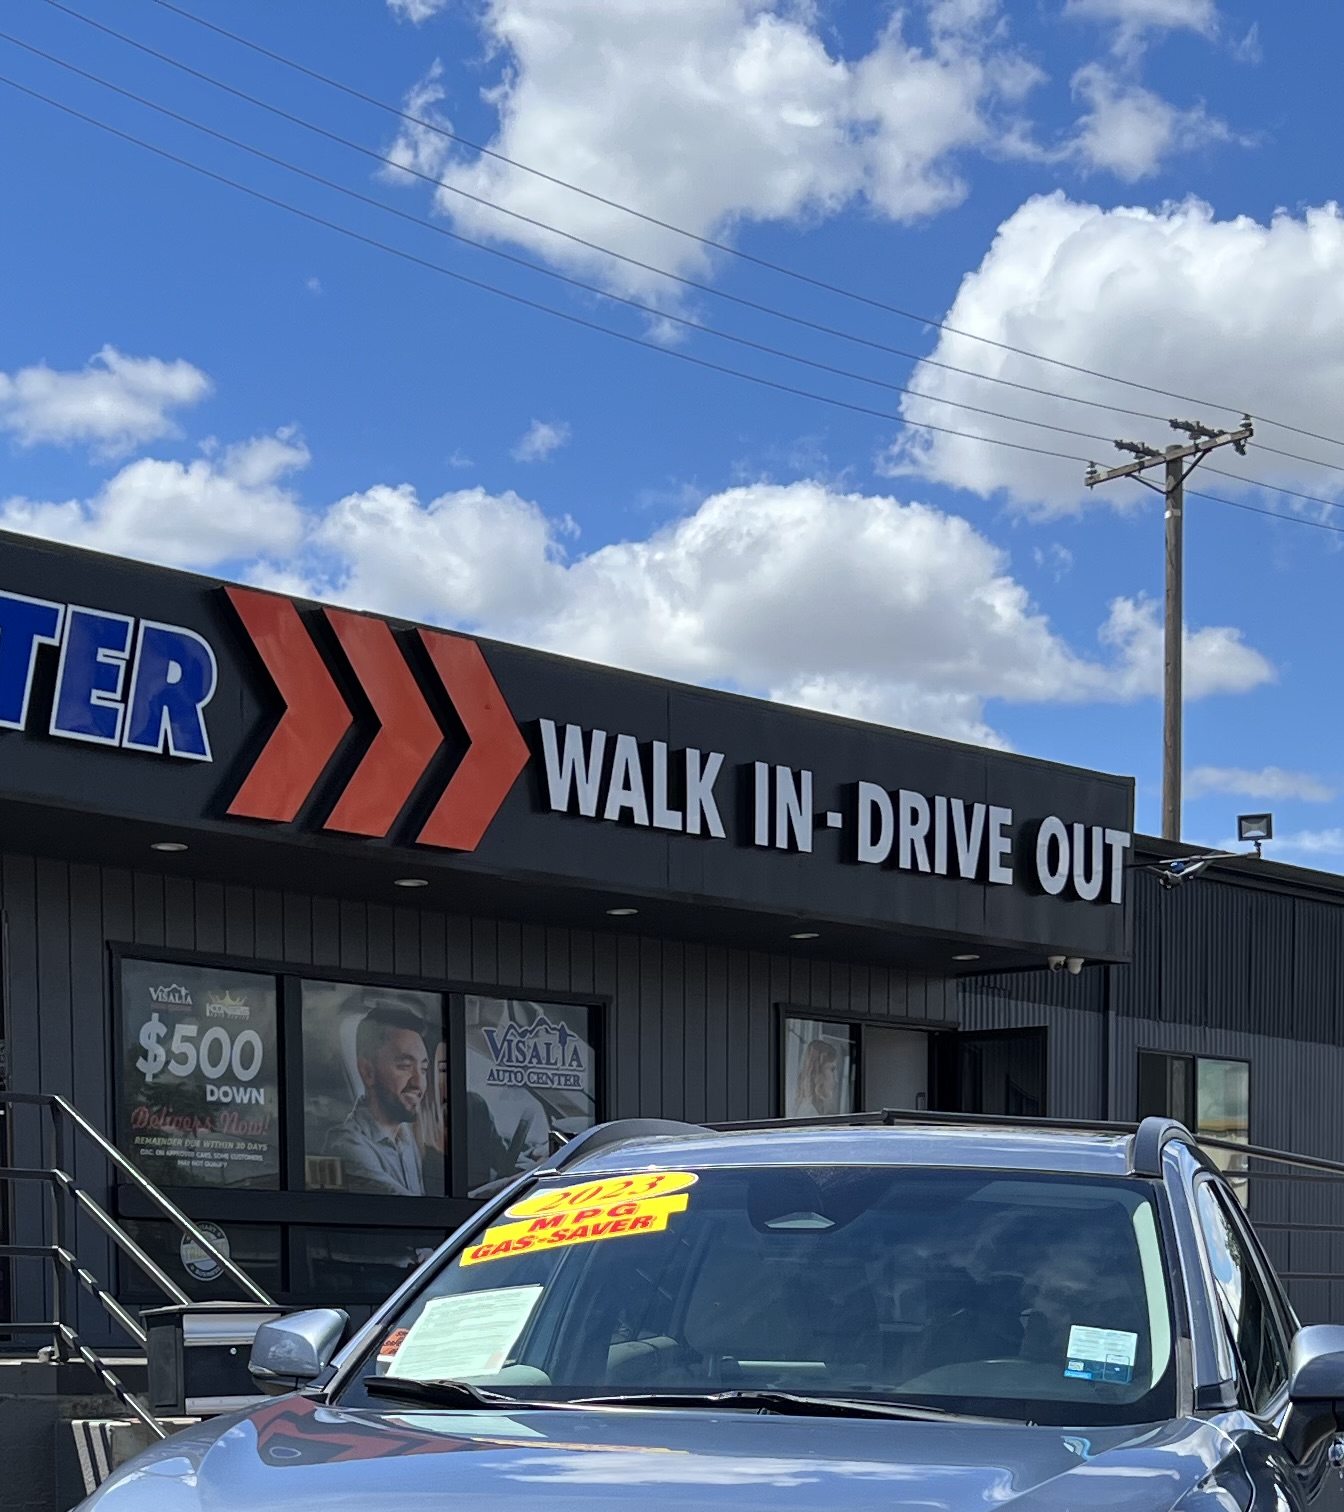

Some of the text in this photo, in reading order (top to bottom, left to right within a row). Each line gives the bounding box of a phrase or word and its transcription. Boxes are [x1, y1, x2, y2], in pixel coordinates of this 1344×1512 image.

[539, 718, 726, 839] WALK
[754, 761, 813, 853] IN
[857, 780, 1014, 885] DRIVE
[1036, 816, 1131, 904] OUT
[149, 984, 193, 1005] VISALIA
[136, 1013, 263, 1082] $500
[482, 1016, 584, 1069] VISALIA
[487, 1068, 582, 1088] AUTO CENTER
[206, 1084, 264, 1105] DOWN
[220, 1111, 272, 1136] Now!
[135, 1136, 268, 1152] REMAINDER DUE WITHIN 30 DAYS
[535, 1176, 666, 1213] 2023
[470, 1215, 657, 1260] GAS-SAVER
